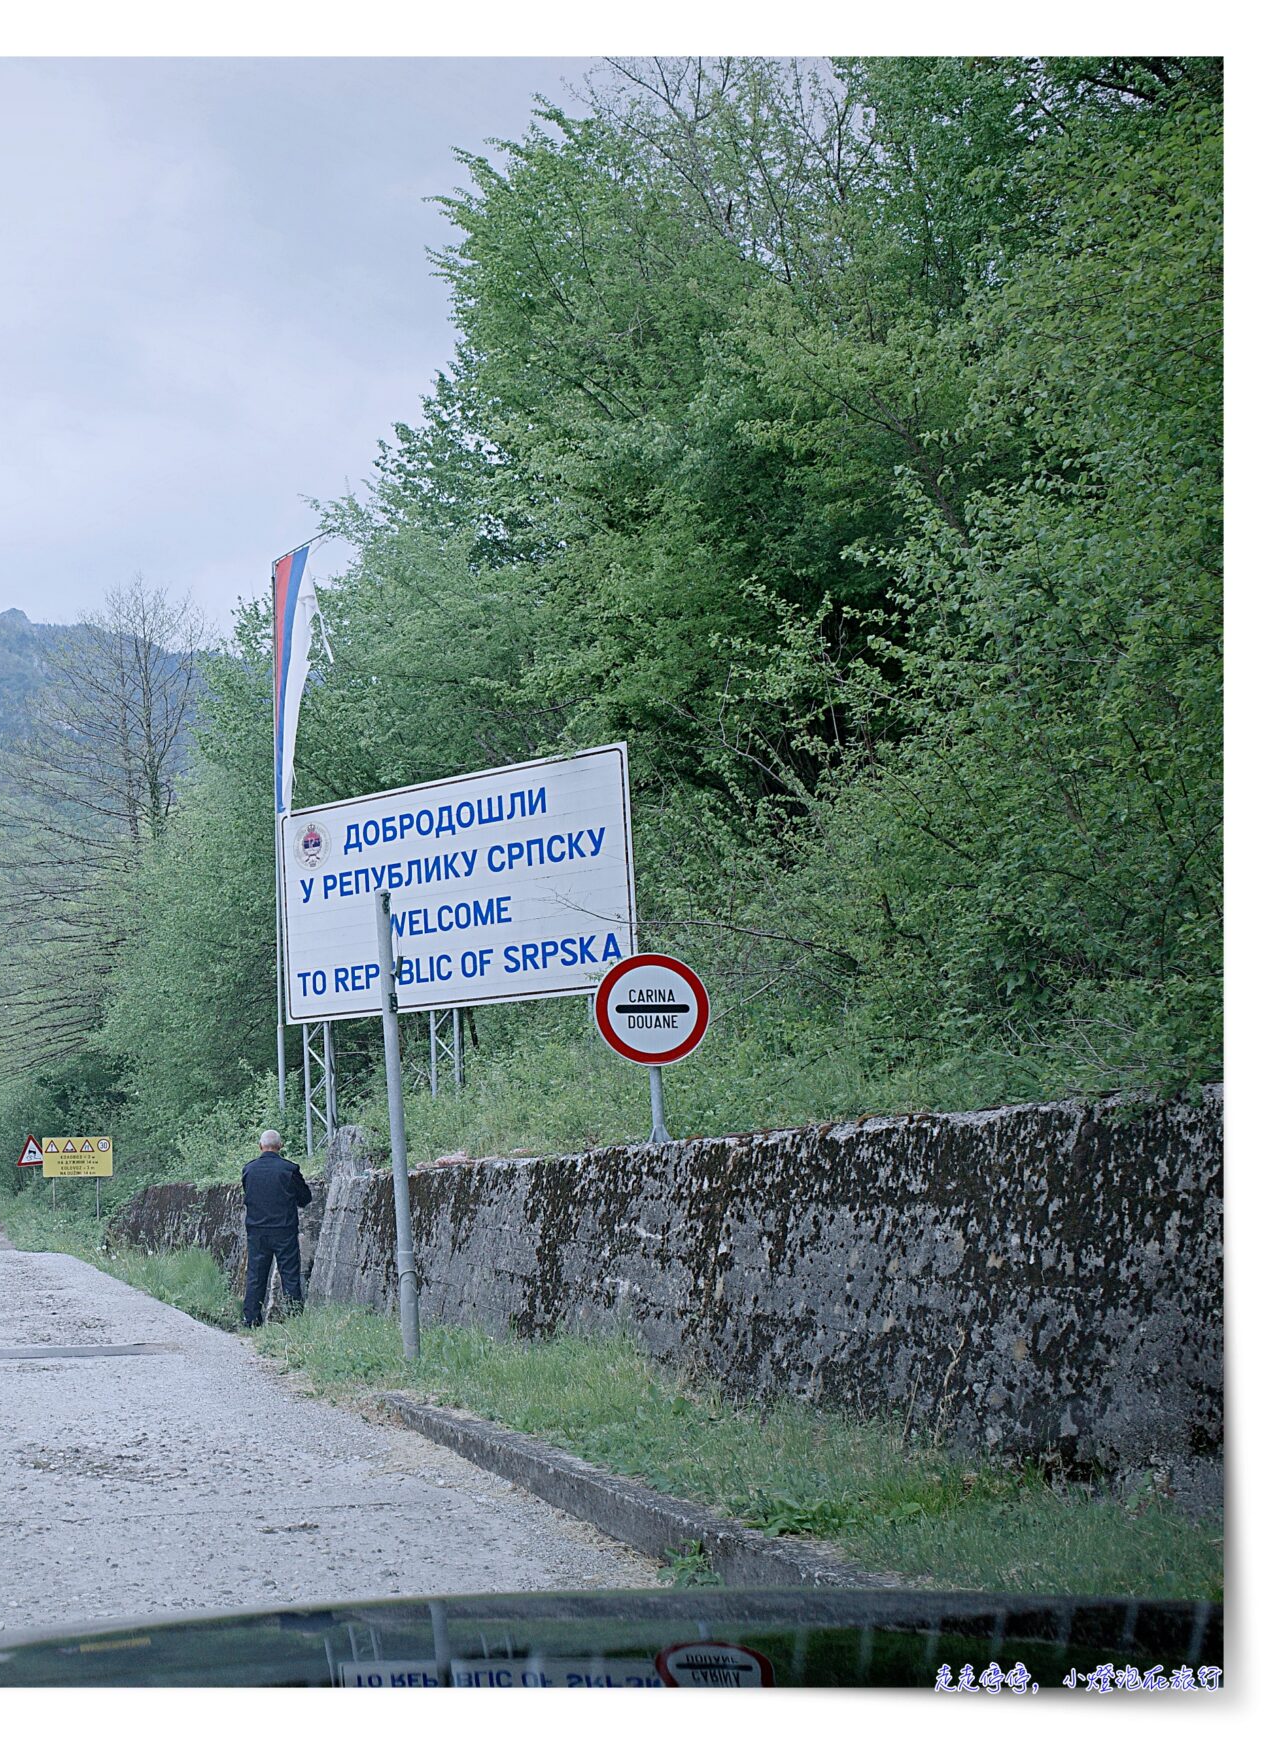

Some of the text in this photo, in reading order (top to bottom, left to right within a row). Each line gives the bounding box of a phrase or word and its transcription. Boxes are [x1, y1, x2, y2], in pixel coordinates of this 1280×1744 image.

[343, 786, 547, 856] ДОБРОДОШЛИ
[299, 826, 607, 904] У РЕПУБЛИКУ СРПСКУ
[297, 932, 624, 997] TO REPBLIC OF SRPSKA
[627, 988, 676, 1003] CARINA
[627, 1015, 679, 1029] DOUANE
